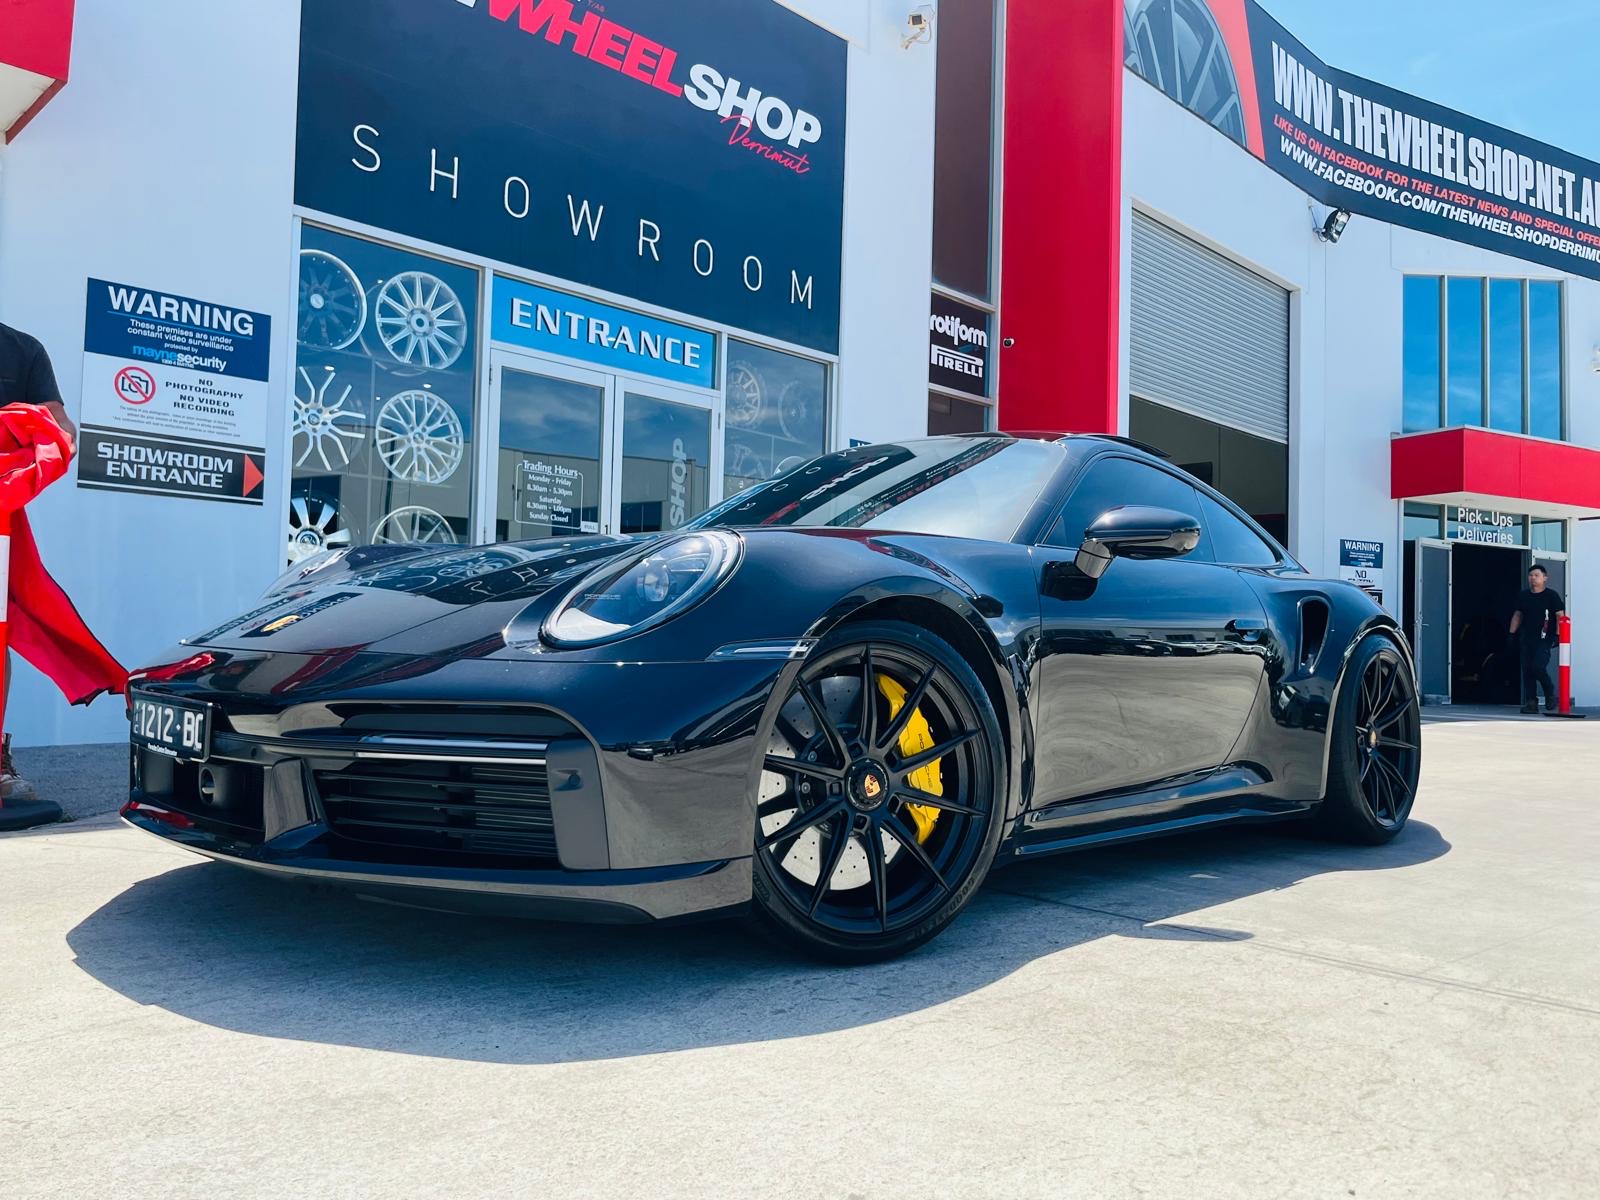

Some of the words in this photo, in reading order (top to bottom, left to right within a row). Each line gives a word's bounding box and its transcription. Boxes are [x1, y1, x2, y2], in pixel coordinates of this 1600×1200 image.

[720, 115, 810, 175] Derrimut
[1274, 114, 1293, 136] LIKE
[1294, 129, 1307, 145] US
[1308, 138, 1322, 155] ON
[1323, 147, 1384, 180] FACEBOOK
[1385, 171, 1410, 187] FOR
[1411, 180, 1433, 195] THE
[1433, 185, 1476, 207] LATEST
[1477, 198, 1509, 217] NEWS
[1510, 210, 1533, 225] AND
[1534, 217, 1575, 239] SPECIAL
[351, 124, 813, 310] SHOWROOM
[108, 285, 254, 337] WARNING
[127, 327, 163, 340] constant
[165, 333, 187, 344] video
[188, 338, 234, 352] surveillance
[130, 319, 155, 330] These
[157, 325, 194, 337] premises
[195, 331, 208, 341] are
[210, 335, 233, 345] under
[511, 297, 701, 369] ENTRANCE
[929, 314, 988, 347] rotiform
[164, 342, 191, 353] protected
[191, 346, 199, 355] by
[931, 343, 984, 378] PIRELLI
[165, 381, 244, 400] PHOTOGRAPHY
[199, 378, 213, 387] NO
[173, 402, 235, 417] RECORDING
[180, 394, 194, 402] NO
[198, 397, 230, 408] VIDEO
[97, 441, 233, 474] SHOWROOM
[523, 460, 553, 476] Trading
[554, 465, 579, 477] Hours
[106, 461, 224, 489] ENTRANCE
[528, 474, 550, 484] Monday
[555, 478, 572, 487] Friday
[670, 438, 687, 527] SHOP
[539, 496, 562, 505] Saturday
[529, 511, 549, 522] Sunday
[550, 514, 569, 523] Closed
[1457, 507, 1482, 524] Pick
[1491, 511, 1513, 529] Ups
[1344, 540, 1381, 553] WARNING
[1457, 525, 1513, 545] Deliveries
